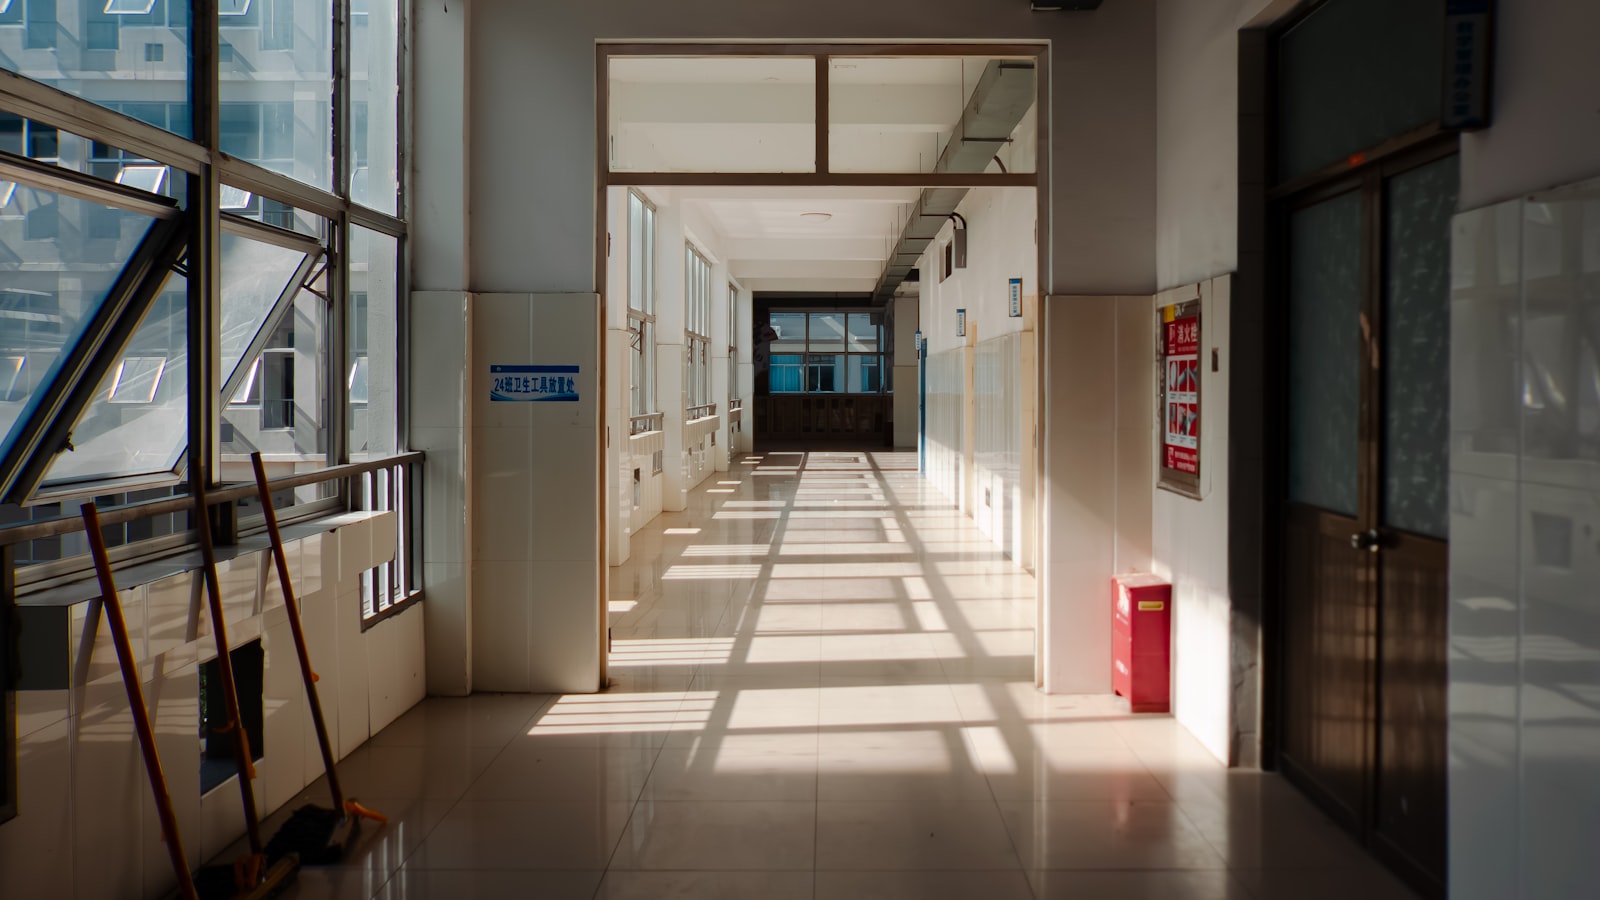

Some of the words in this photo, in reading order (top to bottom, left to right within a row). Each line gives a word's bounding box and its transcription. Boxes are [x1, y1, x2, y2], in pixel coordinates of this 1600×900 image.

[1177, 322, 1198, 344] 消火栓
[494, 376, 575, 393] 24班卫生工具放置处
